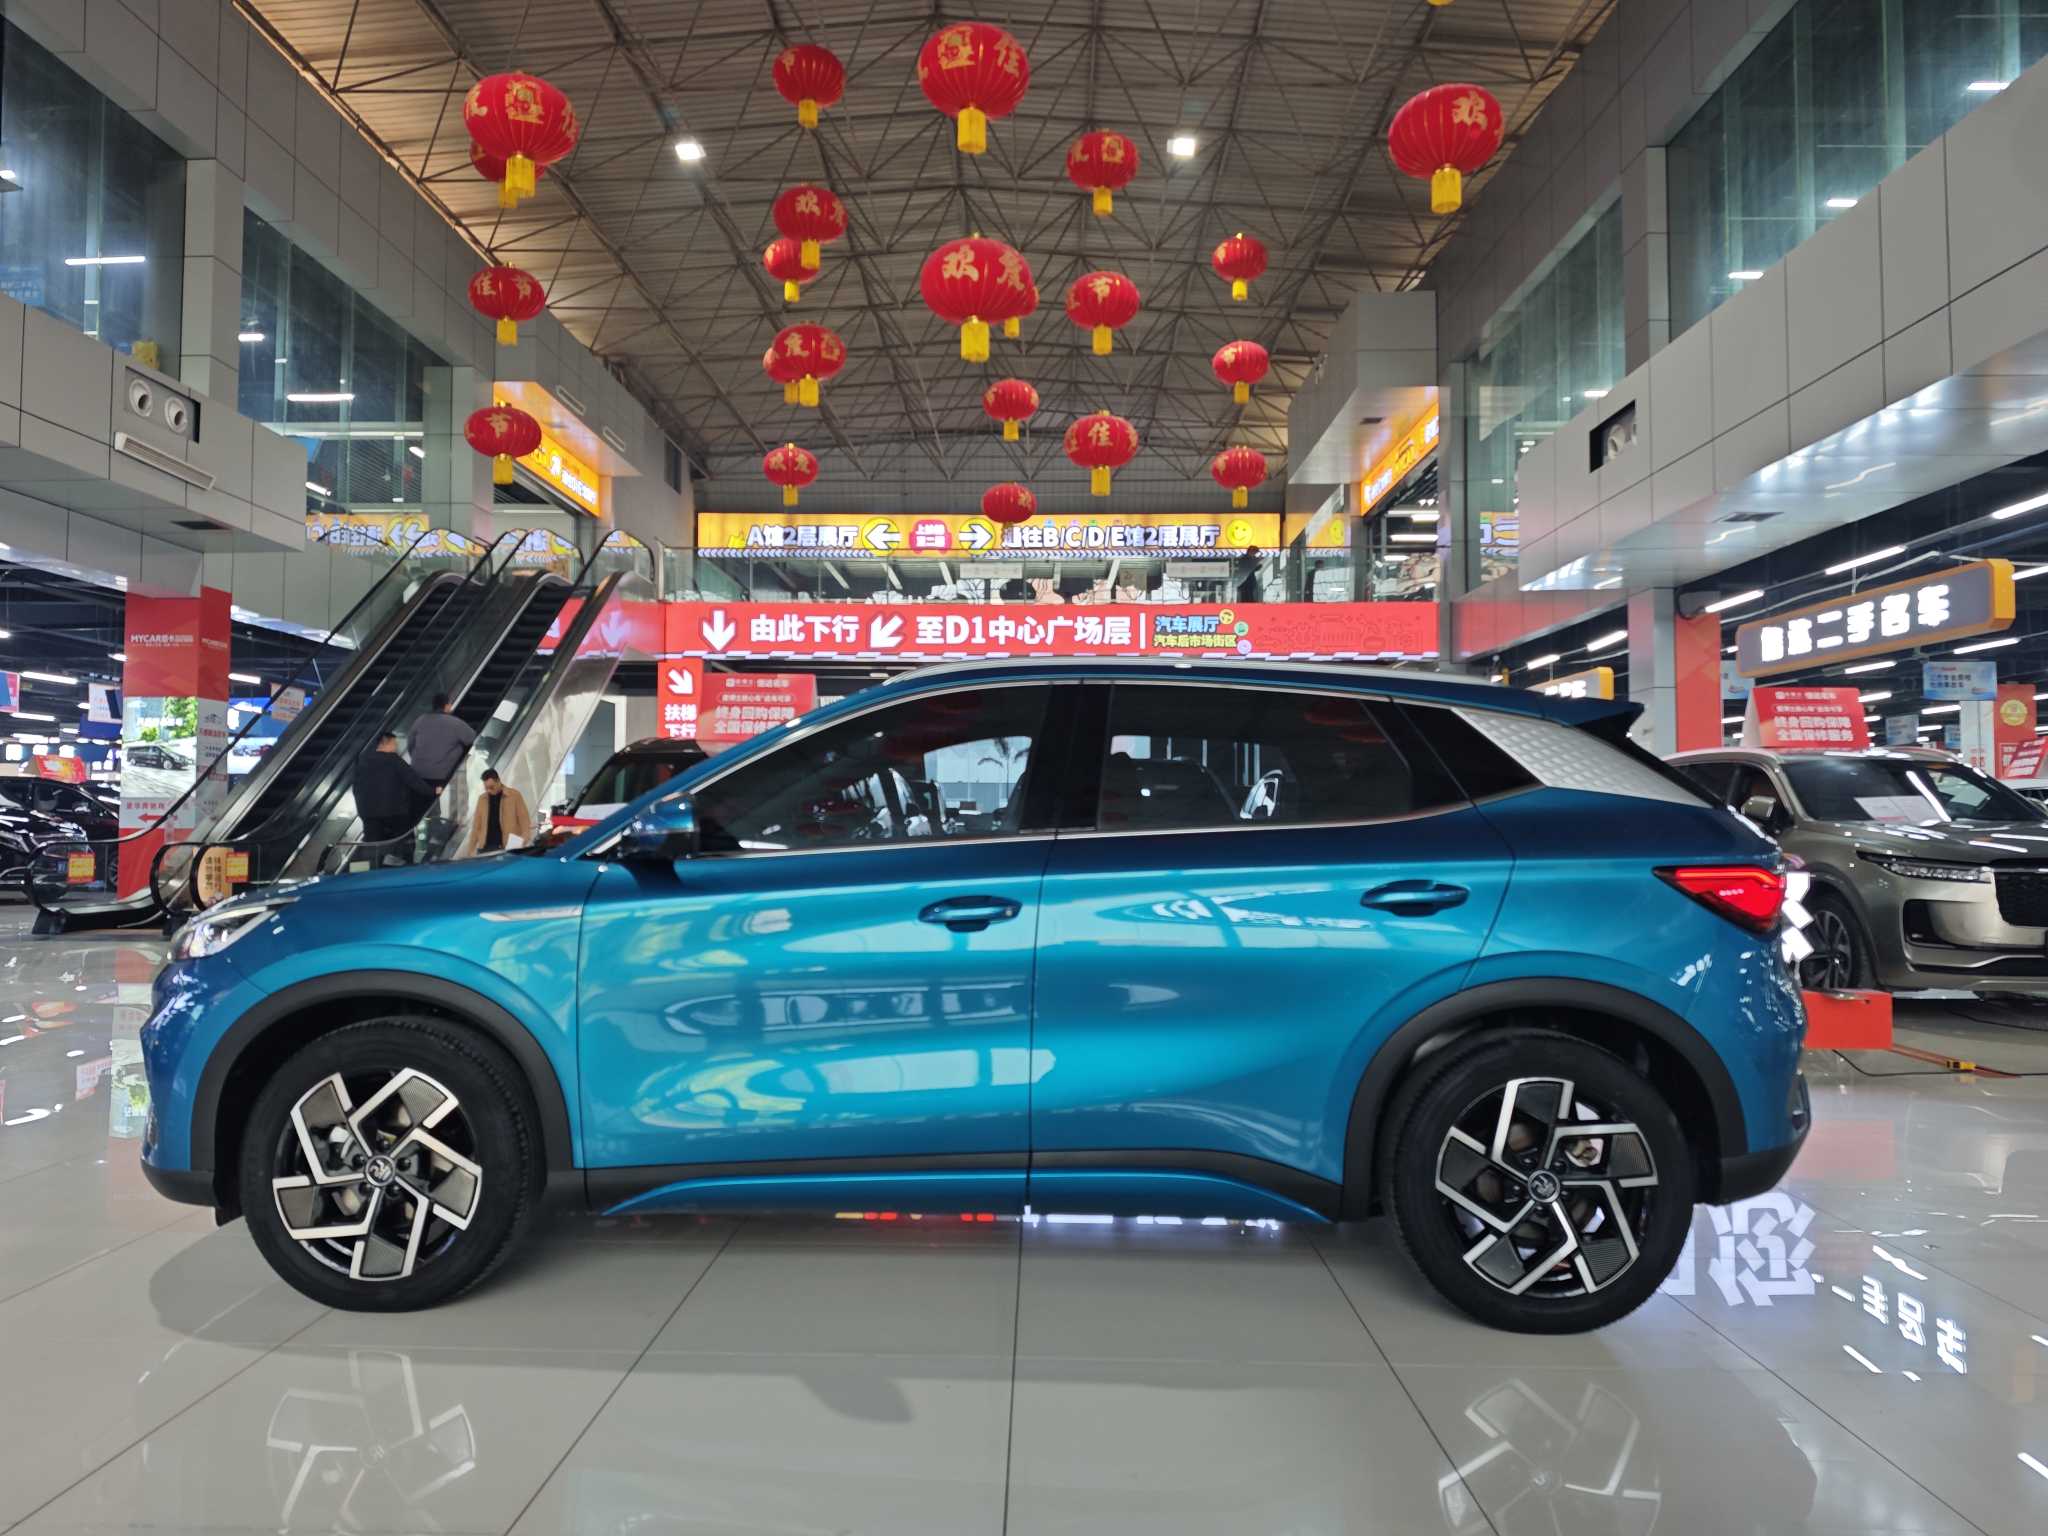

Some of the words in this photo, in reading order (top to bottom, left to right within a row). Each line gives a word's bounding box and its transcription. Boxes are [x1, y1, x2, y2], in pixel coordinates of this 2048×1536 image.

[748, 525, 858, 547] A馆2层展厅
[750, 614, 860, 643] 由此下行
[915, 615, 1132, 646] 至D1中心广场层
[1155, 615, 1219, 633] 汽车展厅
[1153, 634, 1237, 648] 汽车后市场街区
[664, 704, 698, 721] 扶梯
[664, 724, 697, 738] 下行
